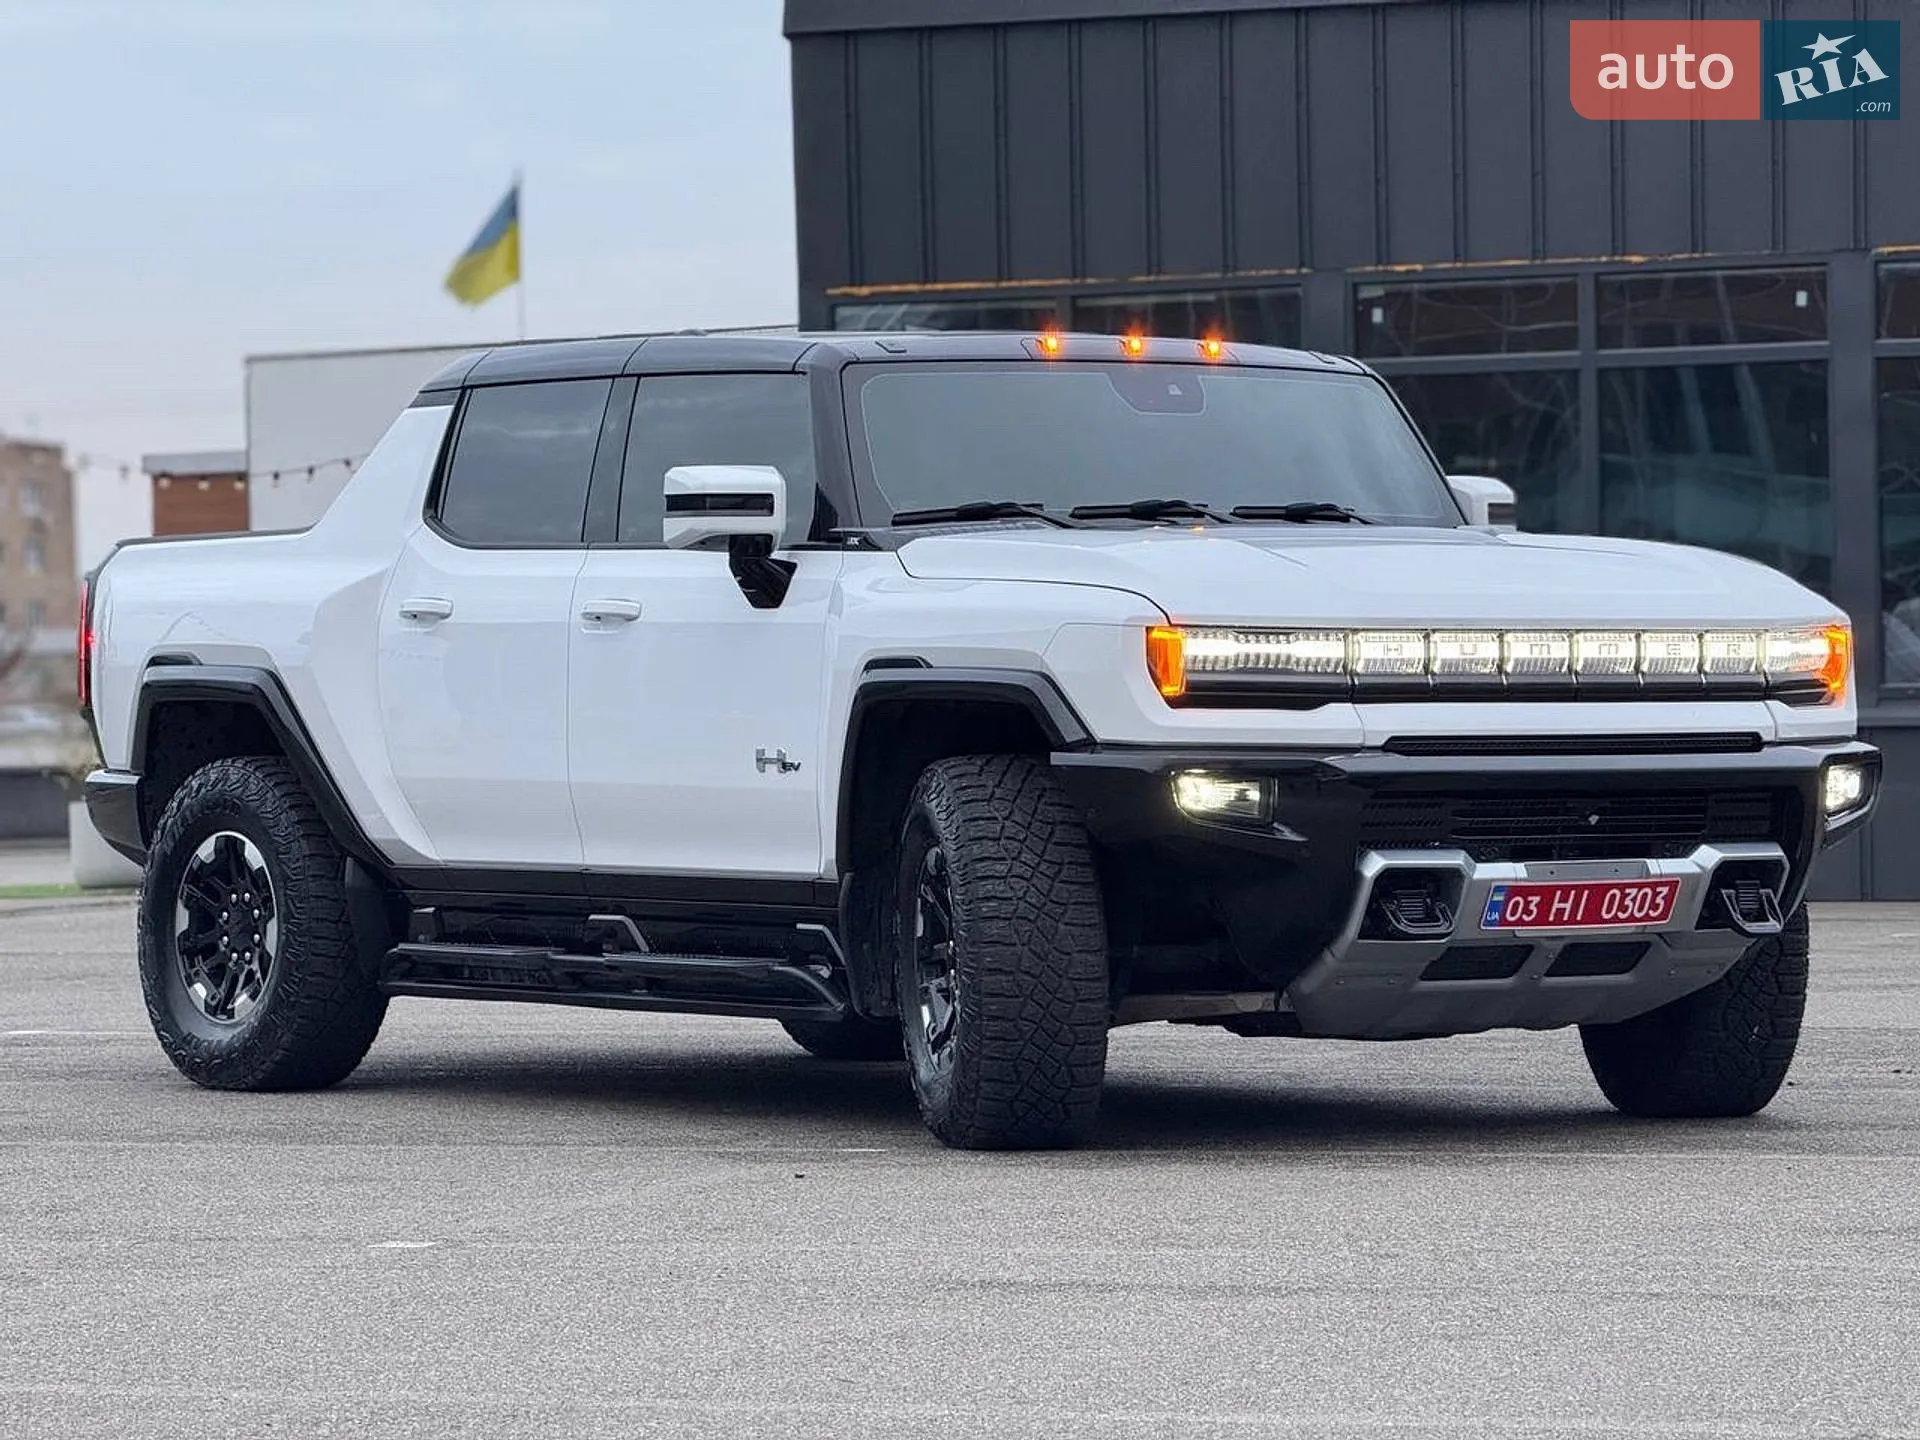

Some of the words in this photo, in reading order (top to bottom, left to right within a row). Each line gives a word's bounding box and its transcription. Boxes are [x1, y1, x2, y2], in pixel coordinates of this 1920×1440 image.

[1505, 895, 1541, 922] 03
[1548, 889, 1590, 922] HI
[1600, 886, 1671, 920] 0303
